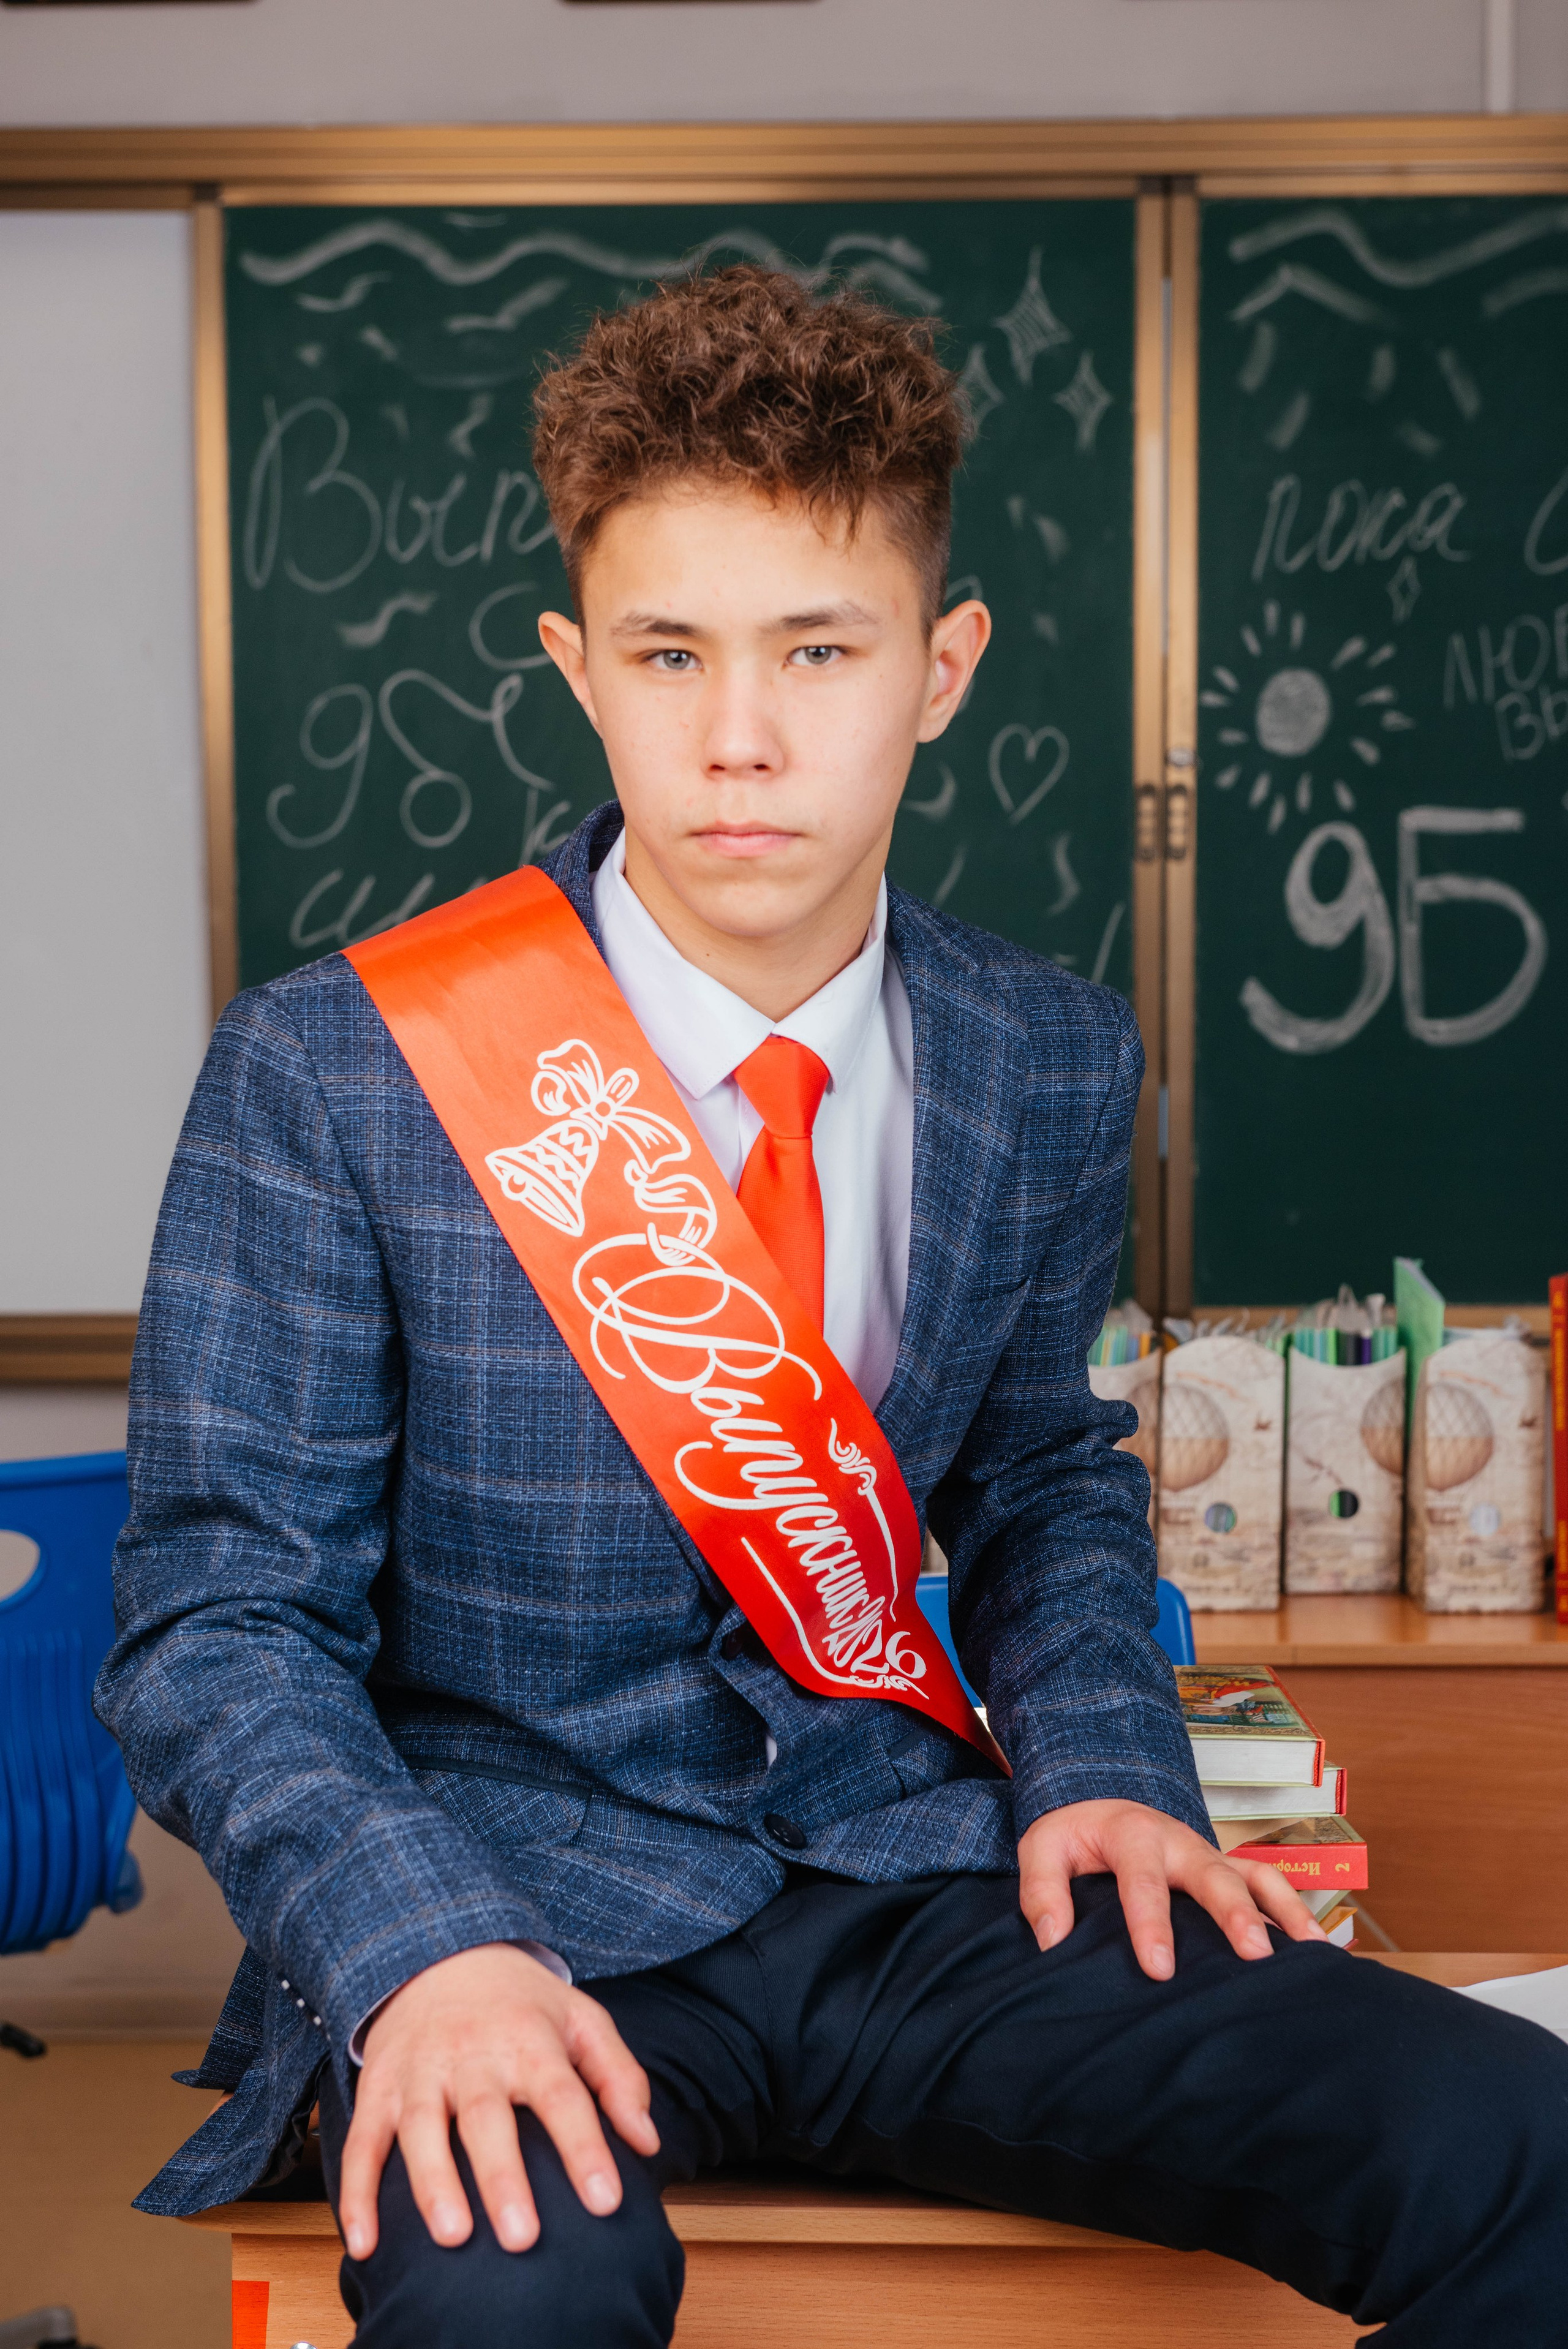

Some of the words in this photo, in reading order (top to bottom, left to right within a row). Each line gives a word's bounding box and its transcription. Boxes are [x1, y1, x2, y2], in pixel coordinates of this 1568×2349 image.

[1238, 804, 1550, 1055] 9Б
[571, 1232, 870, 1631] Выпускник
[821, 1596, 927, 1680] 2026
